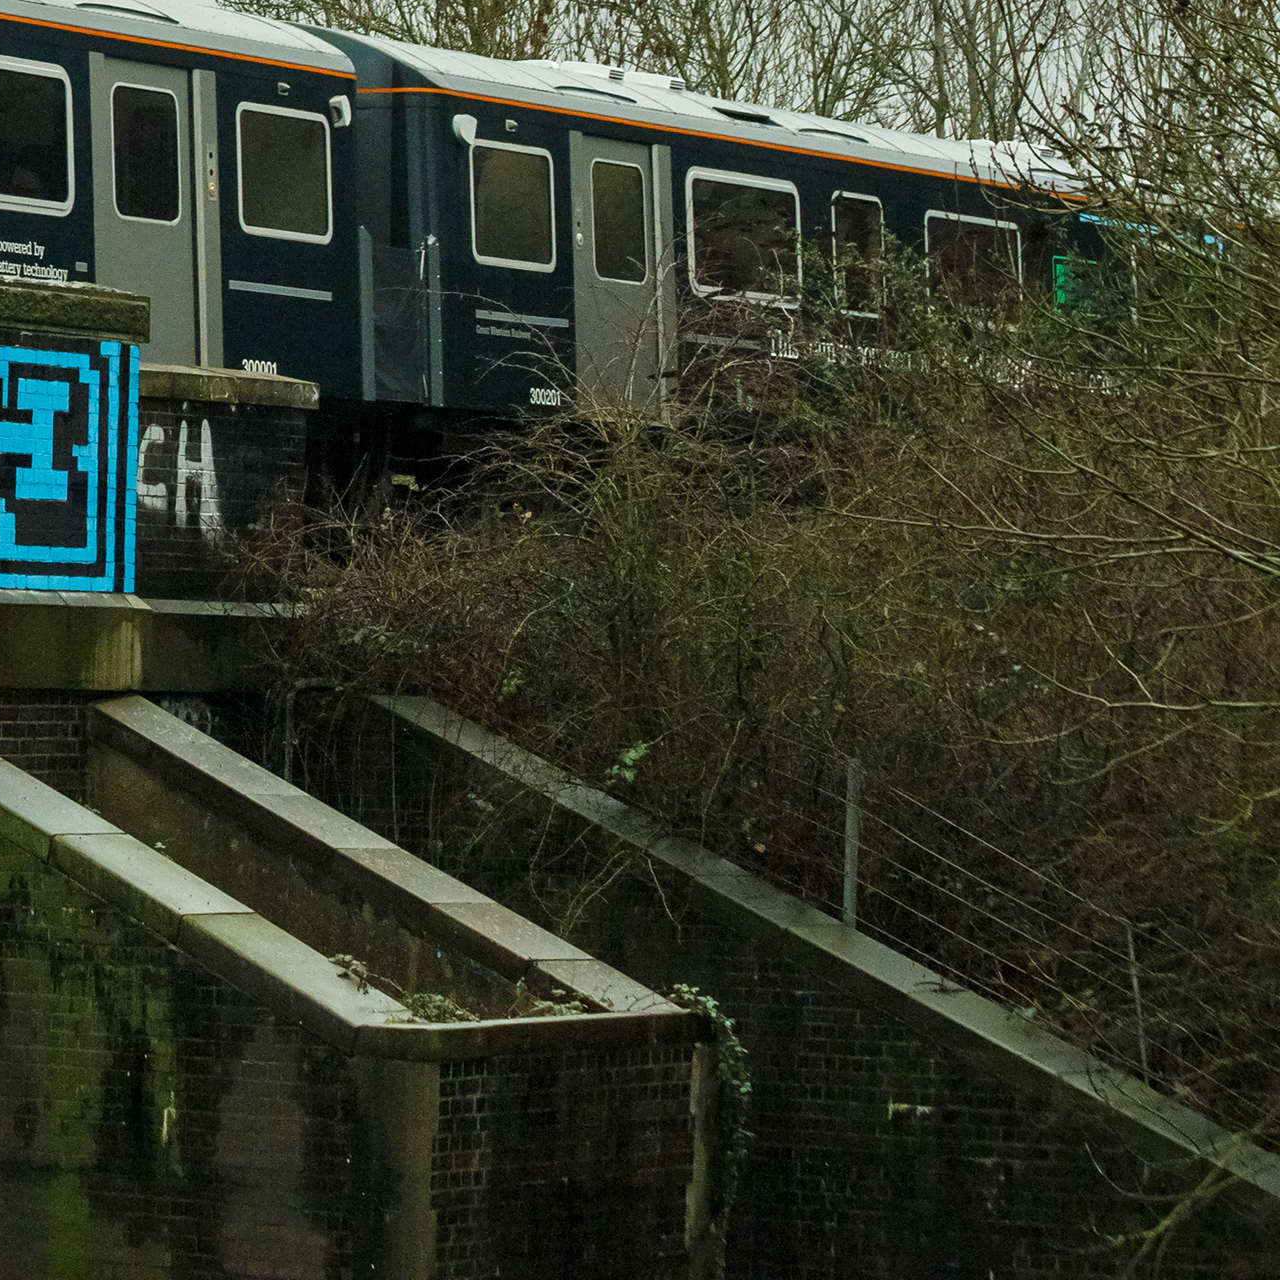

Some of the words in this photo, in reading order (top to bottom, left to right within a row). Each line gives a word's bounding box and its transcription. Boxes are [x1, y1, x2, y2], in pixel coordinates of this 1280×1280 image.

[34, 242, 46, 259] by
[23, 263, 69, 283] technology
[242, 358, 278, 376] 300001
[529, 387, 561, 407] 300201
